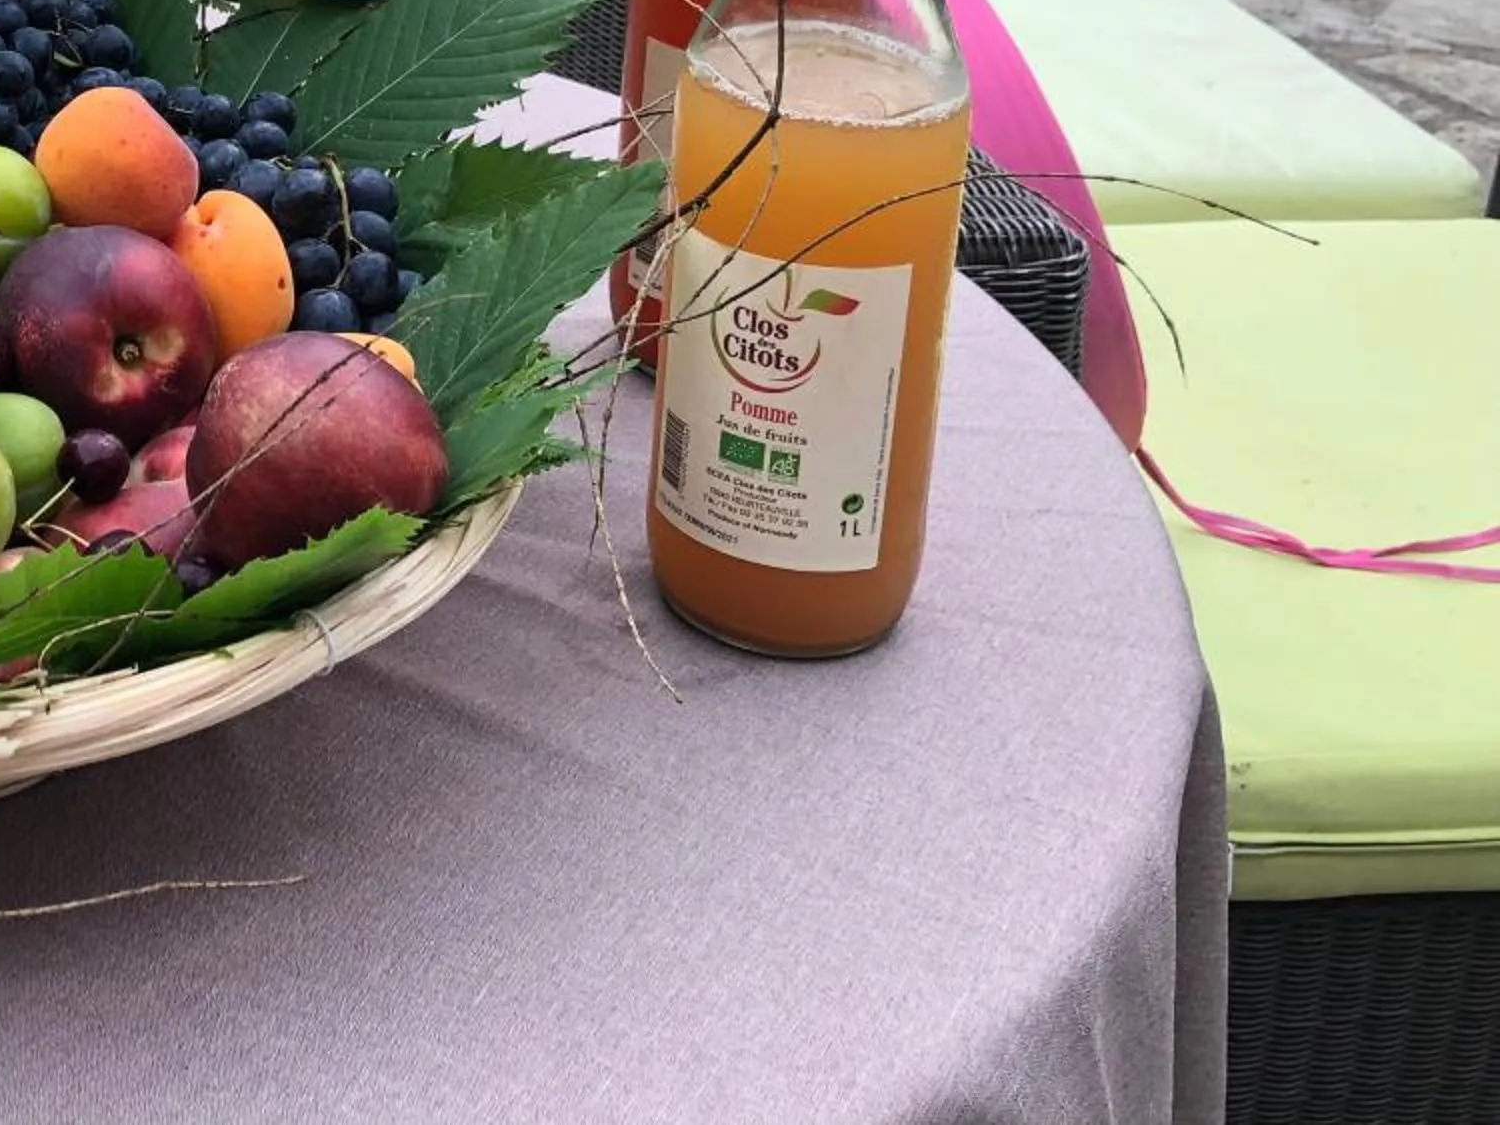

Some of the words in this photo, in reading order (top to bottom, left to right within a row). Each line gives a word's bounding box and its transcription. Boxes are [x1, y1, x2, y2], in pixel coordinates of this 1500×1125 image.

[733, 305, 790, 341] Clos
[723, 332, 800, 373] Citots
[757, 336, 777, 350] des
[731, 391, 798, 427] Pomme
[716, 414, 740, 431] Jus
[743, 419, 761, 437] de
[765, 426, 808, 447] fruits
